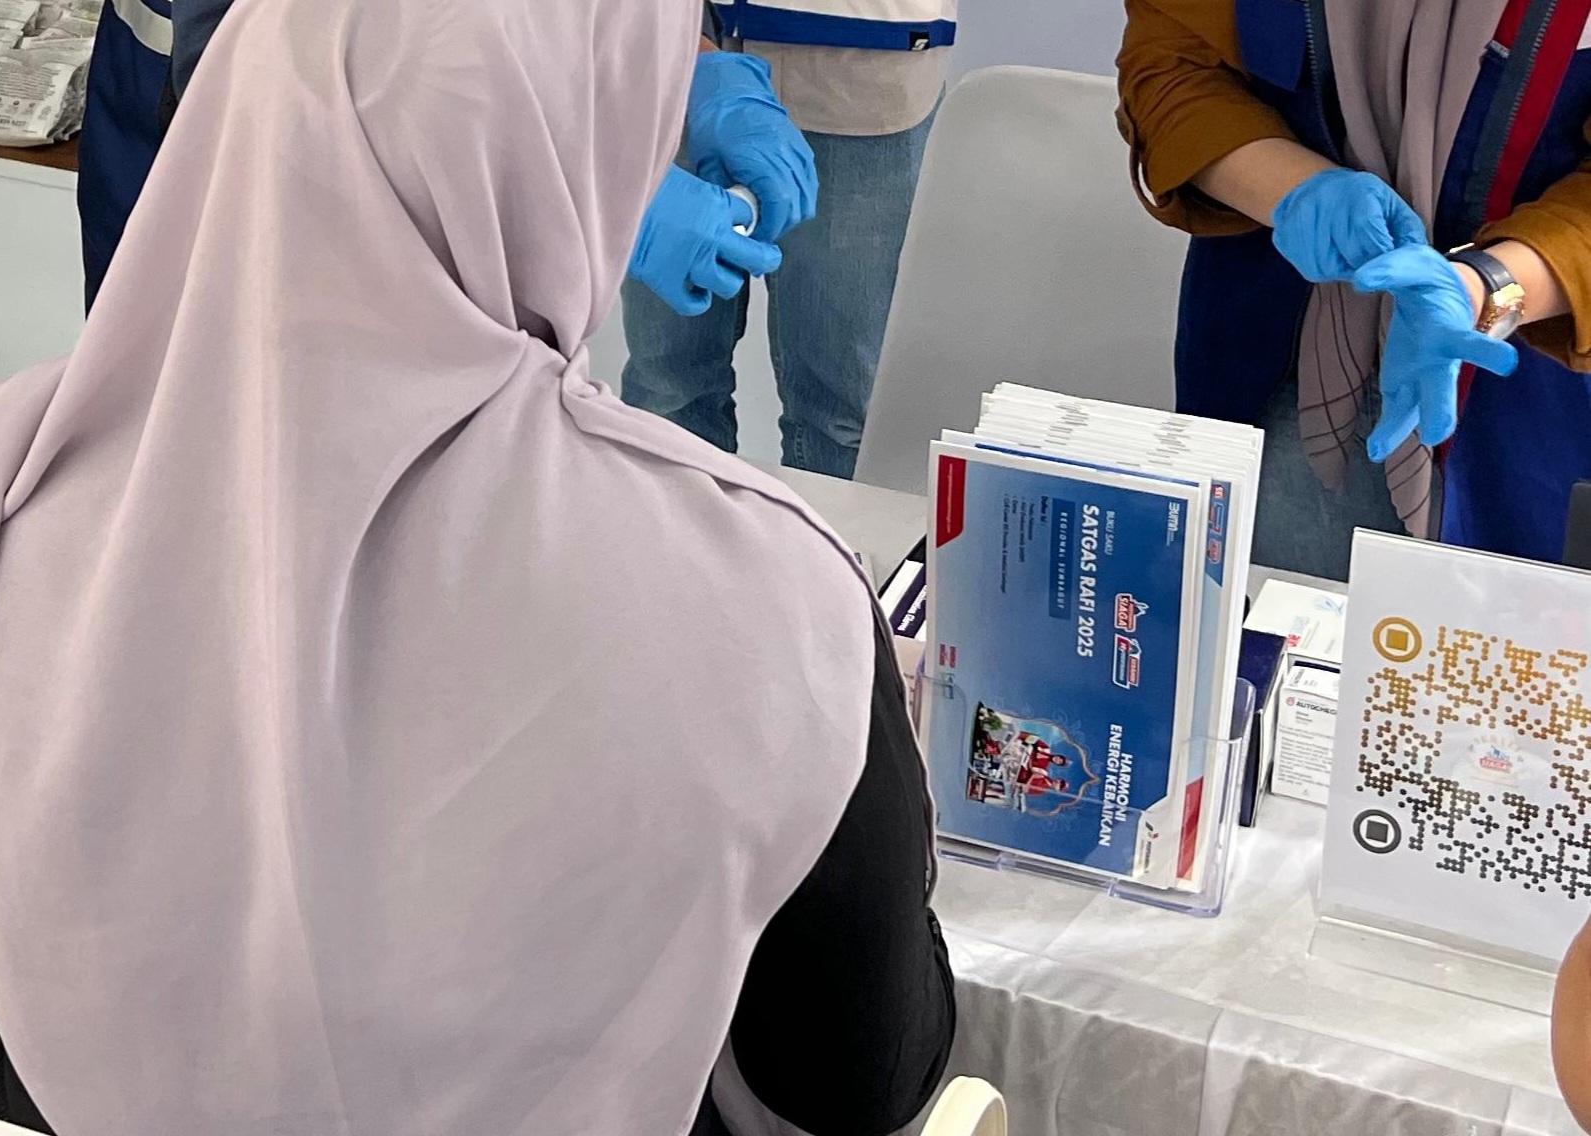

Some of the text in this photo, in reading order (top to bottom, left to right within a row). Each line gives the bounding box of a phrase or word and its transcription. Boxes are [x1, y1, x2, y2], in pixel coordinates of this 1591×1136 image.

[1057, 512, 1068, 610] REGIONAL SUMBAGUT
[1104, 510, 1116, 556] BUKU SAKU
[1077, 504, 1100, 658] SATGAS RAFI 2025
[1118, 596, 1130, 627] SIAGA
[1296, 701, 1338, 715] AUTOCHEC
[1098, 723, 1122, 847] ENERGI KEBAIKAN
[1114, 752, 1133, 822] HARMONI
